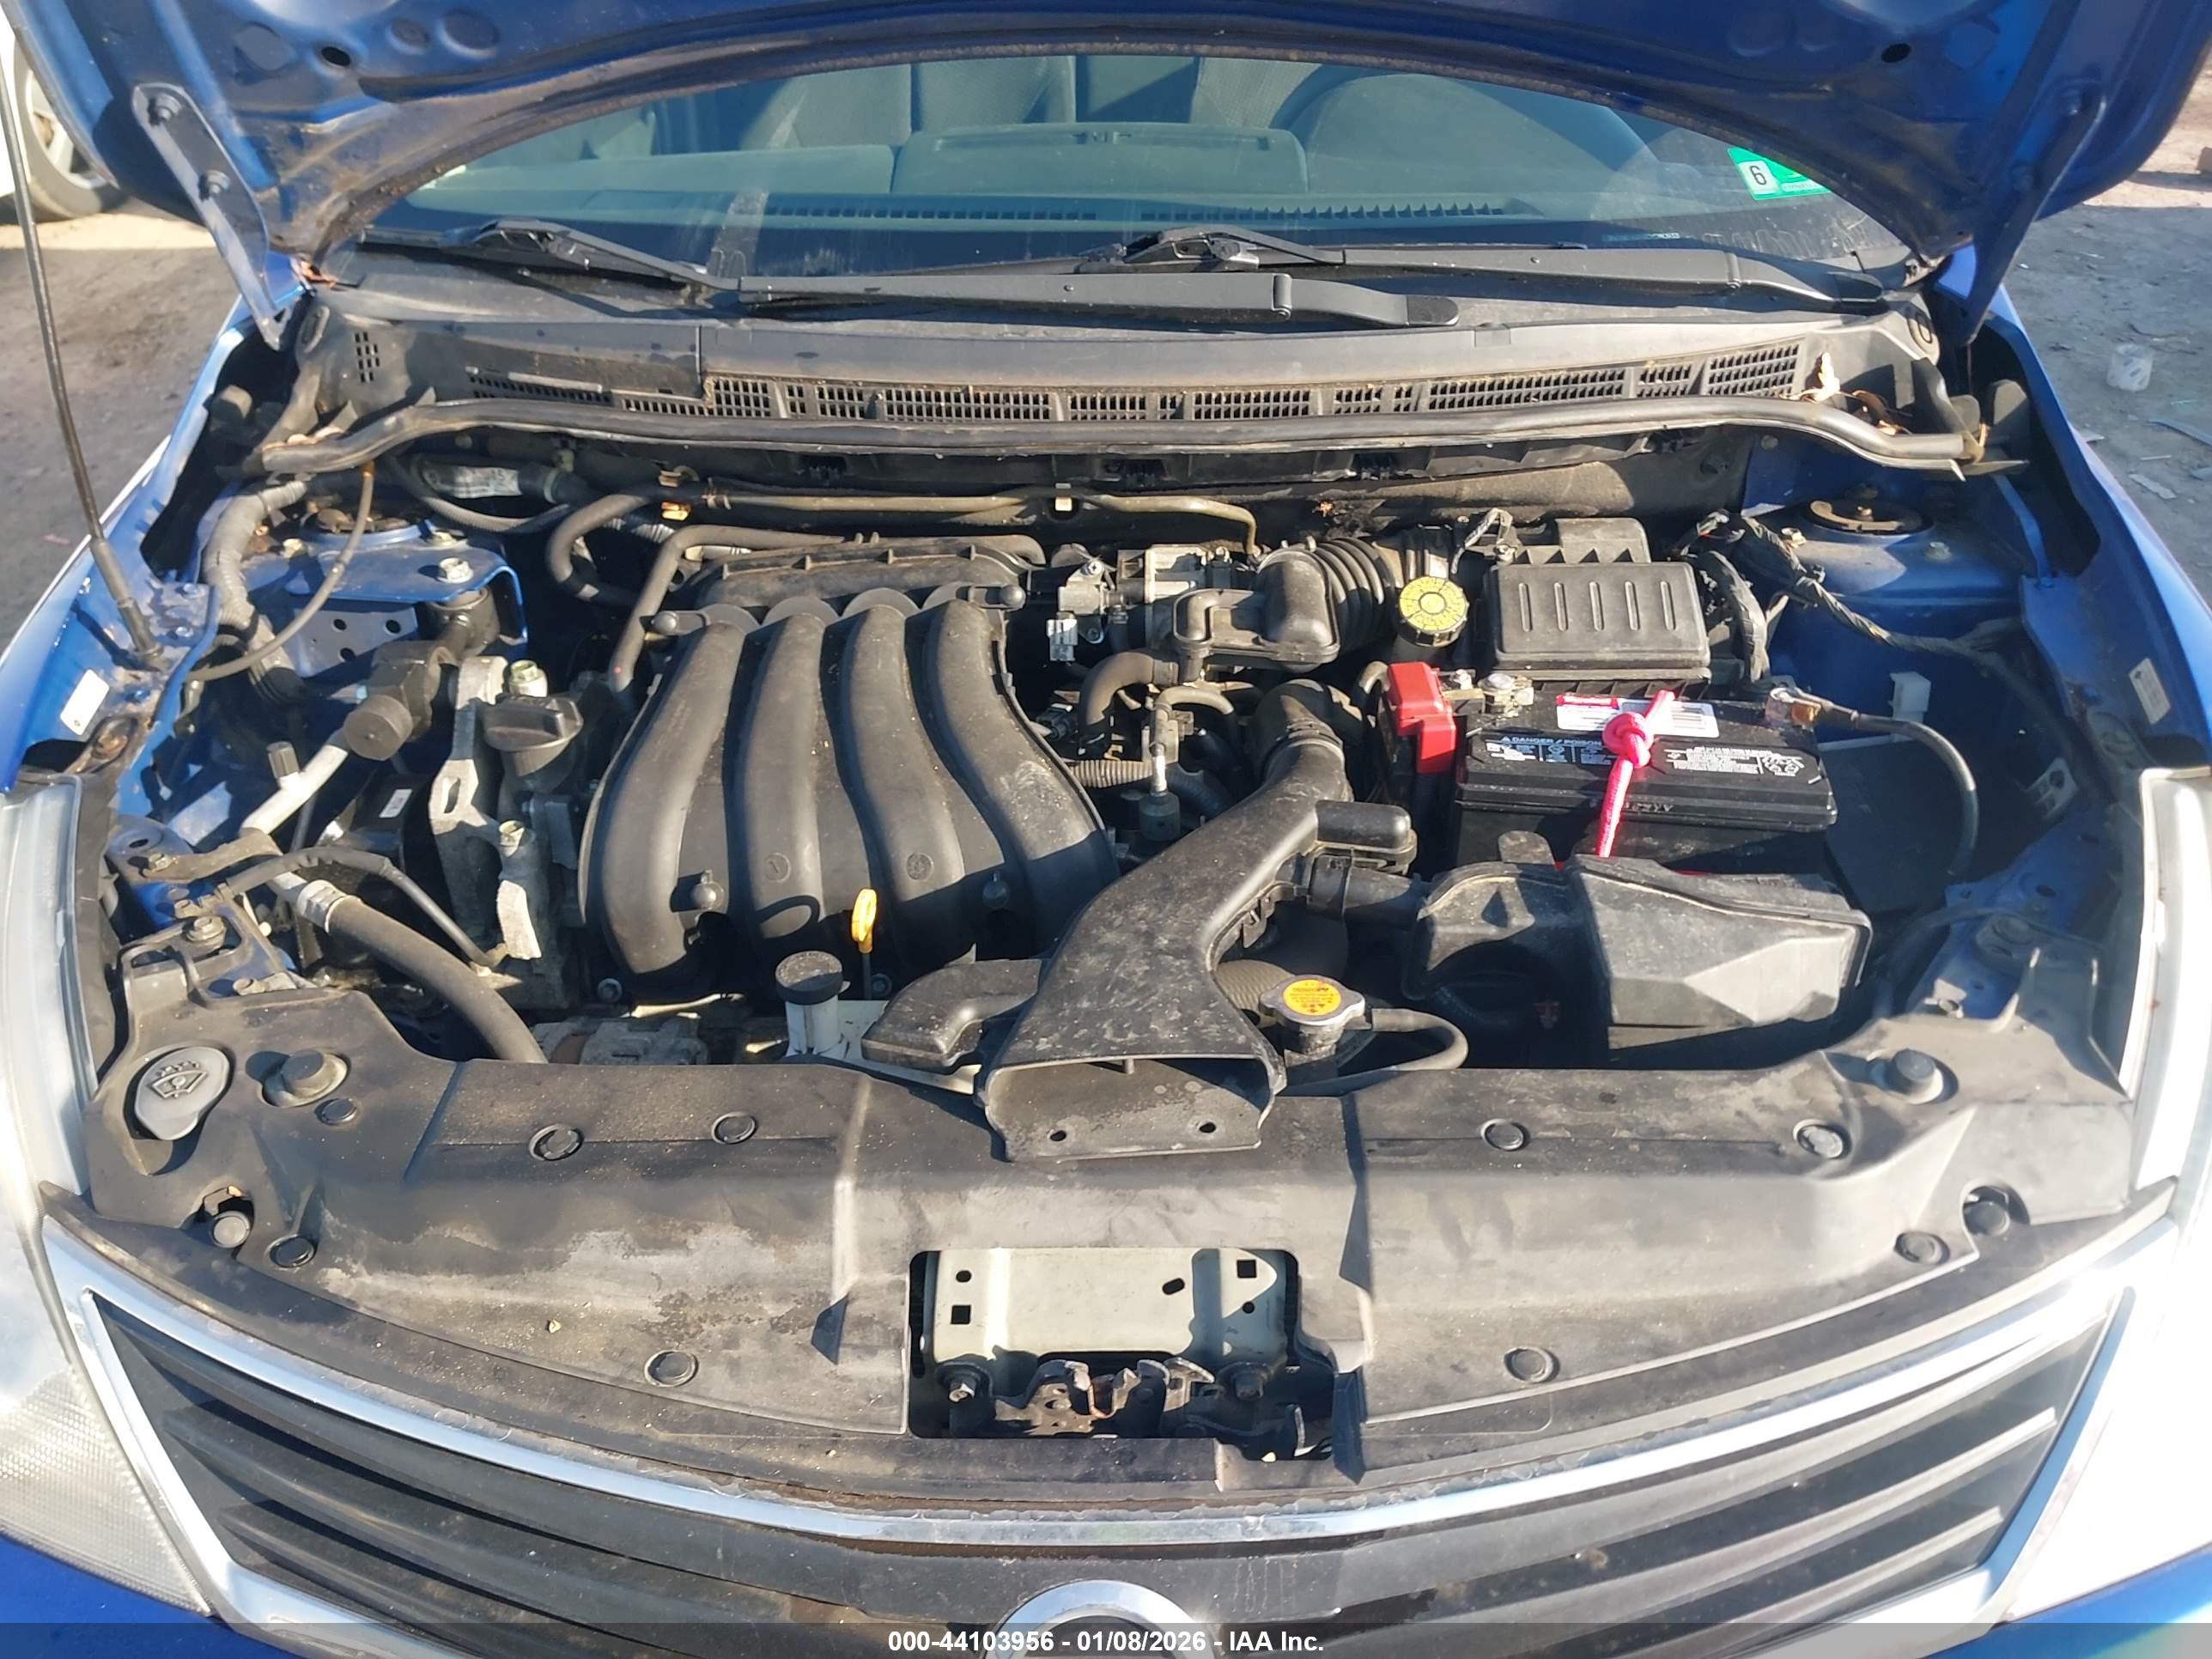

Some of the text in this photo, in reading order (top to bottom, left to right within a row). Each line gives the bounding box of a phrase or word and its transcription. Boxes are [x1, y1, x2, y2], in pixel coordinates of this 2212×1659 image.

[1749, 165, 1767, 185] 6
[1511, 736, 1554, 745] DANGER
[1564, 738, 1602, 747] POISON
